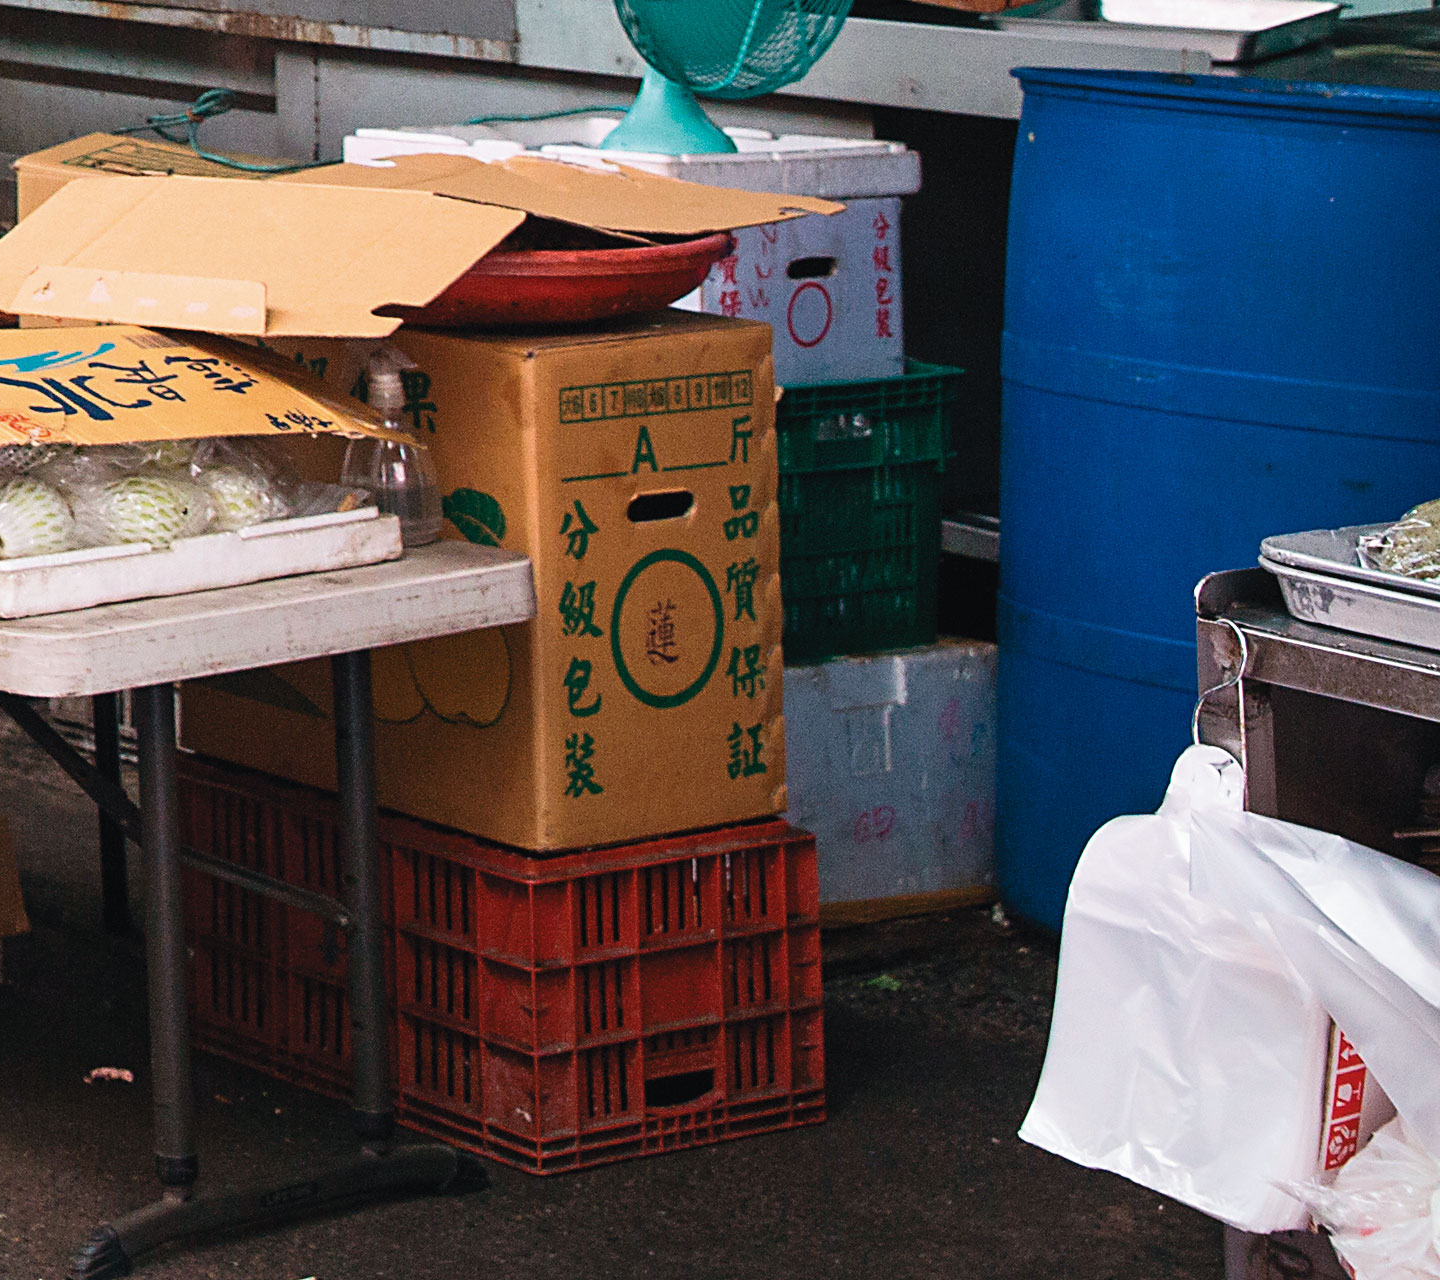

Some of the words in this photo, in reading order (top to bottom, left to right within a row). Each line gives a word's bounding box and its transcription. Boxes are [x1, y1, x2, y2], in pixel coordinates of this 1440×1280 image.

[729, 414, 754, 464] 斤
[558, 499, 604, 800] 分級包裝
[722, 485, 768, 781] 品質保証
